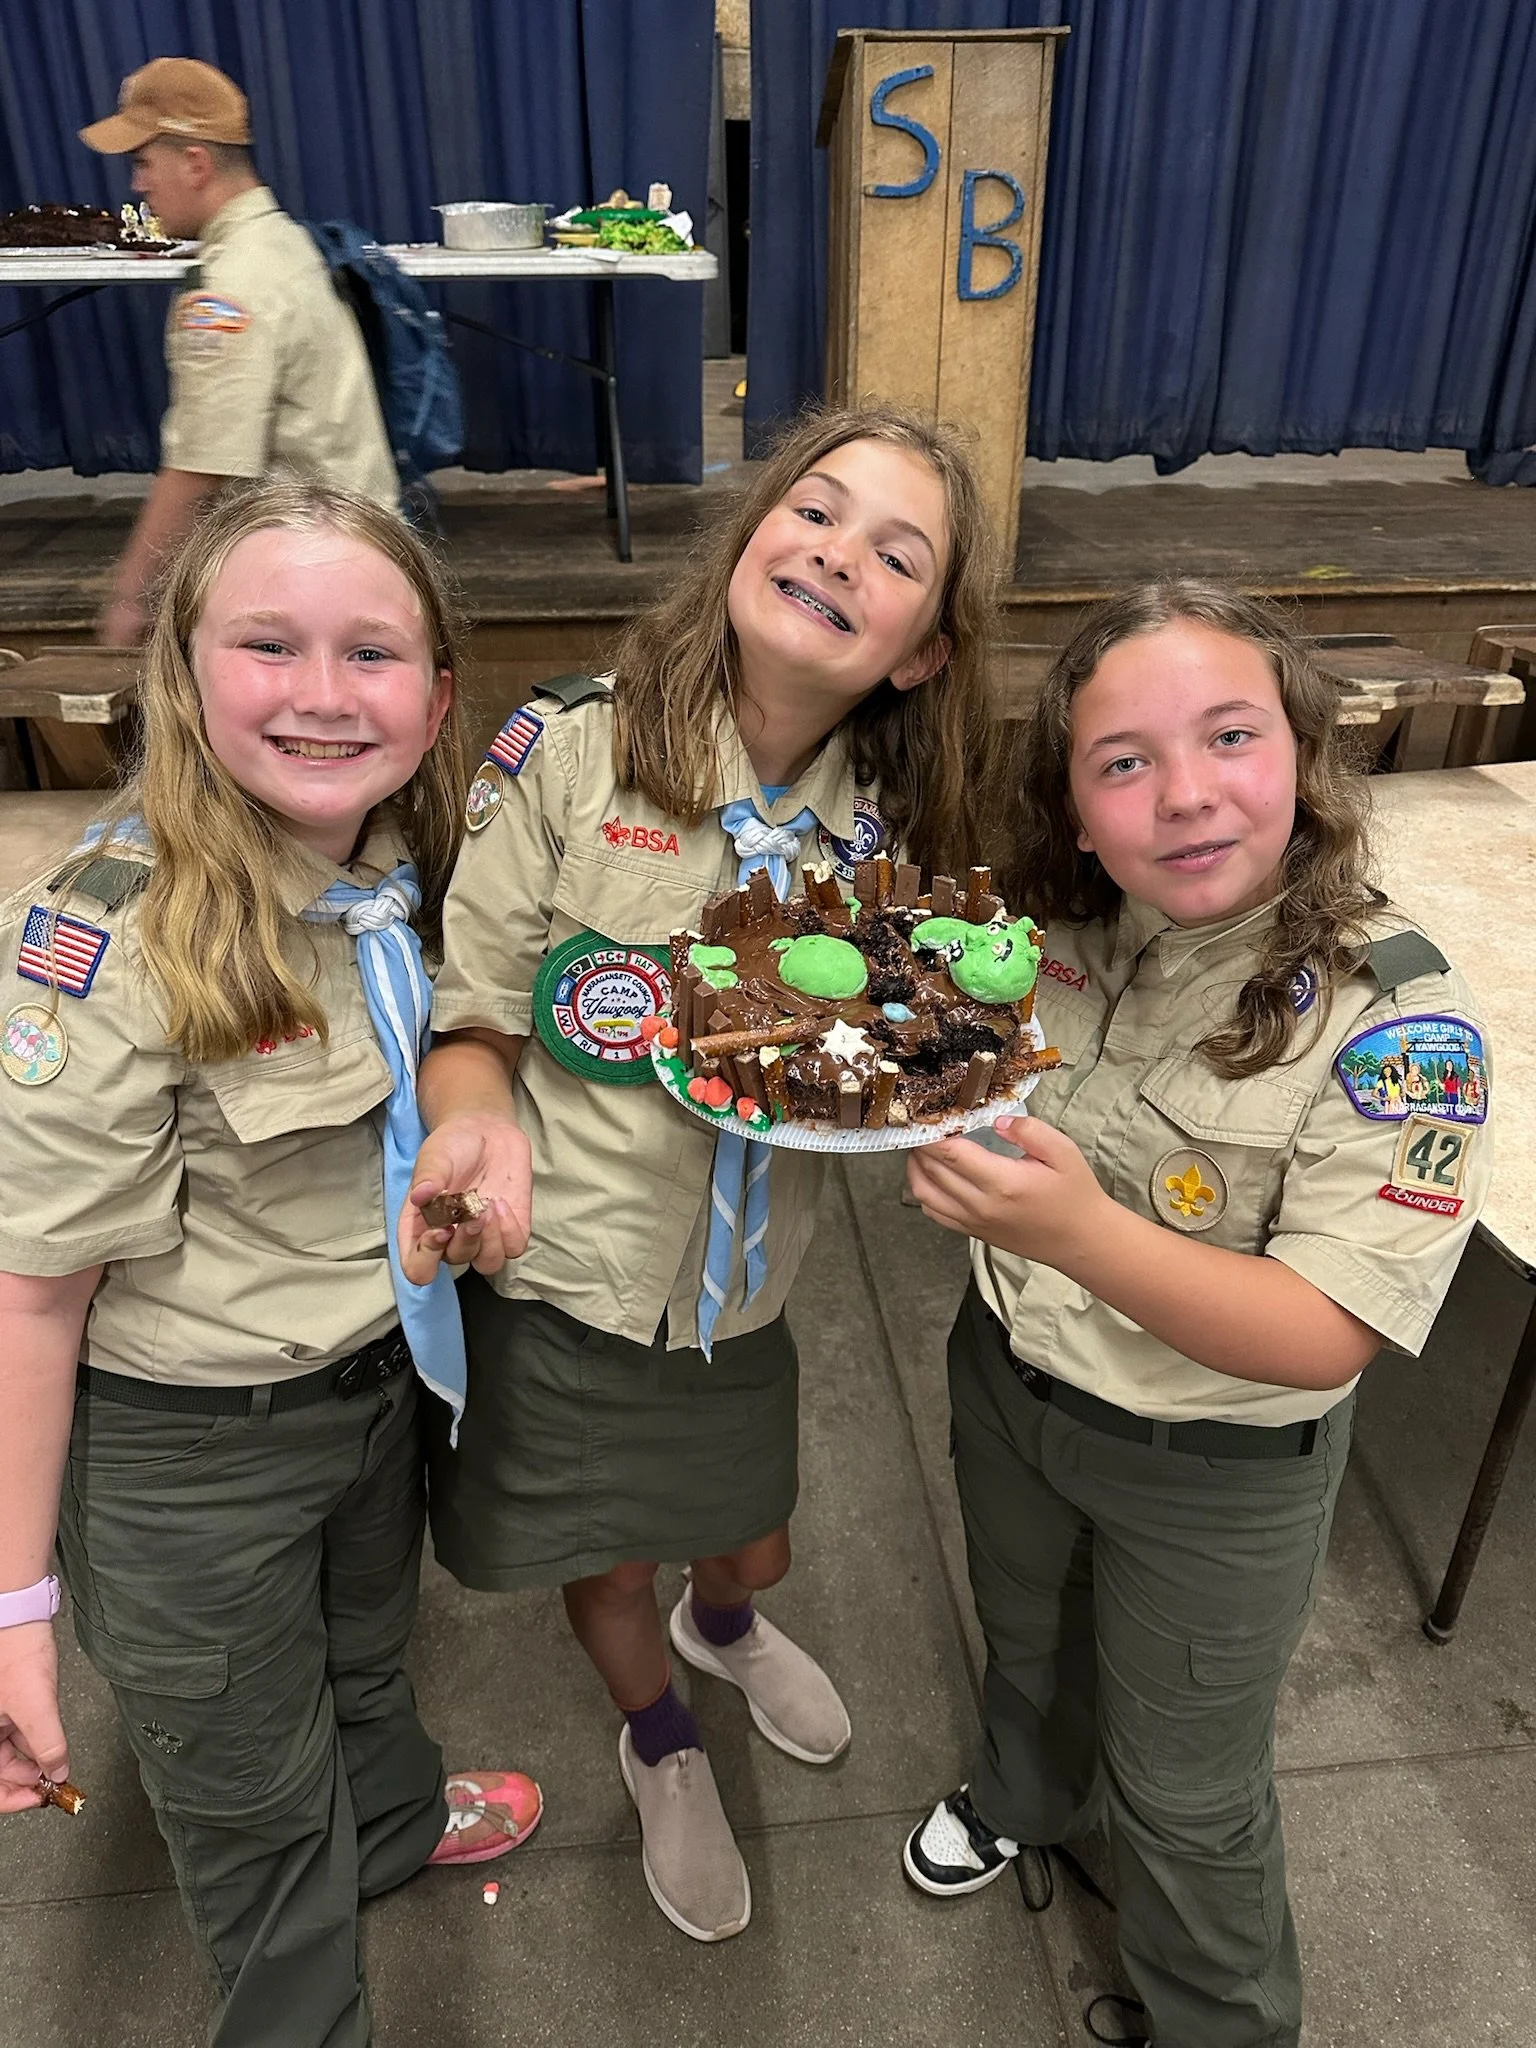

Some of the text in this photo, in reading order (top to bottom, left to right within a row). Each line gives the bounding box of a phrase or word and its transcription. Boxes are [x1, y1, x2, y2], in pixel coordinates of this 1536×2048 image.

[864, 64, 1026, 301] S B
[631, 826, 680, 856] BSA
[635, 957, 653, 971] HAT
[1043, 960, 1087, 991] BSA
[601, 985, 638, 999] CAMP
[582, 996, 652, 1020] Yawgoog
[1386, 1023, 1439, 1040] WELCOME
[1439, 1024, 1464, 1037] GIRLS
[1423, 1033, 1451, 1043] CAMP
[579, 1040, 593, 1052] RI
[614, 1051, 620, 1059] 1
[1406, 1129, 1462, 1186] 42
[1384, 1187, 1456, 1213] FOUNDER
